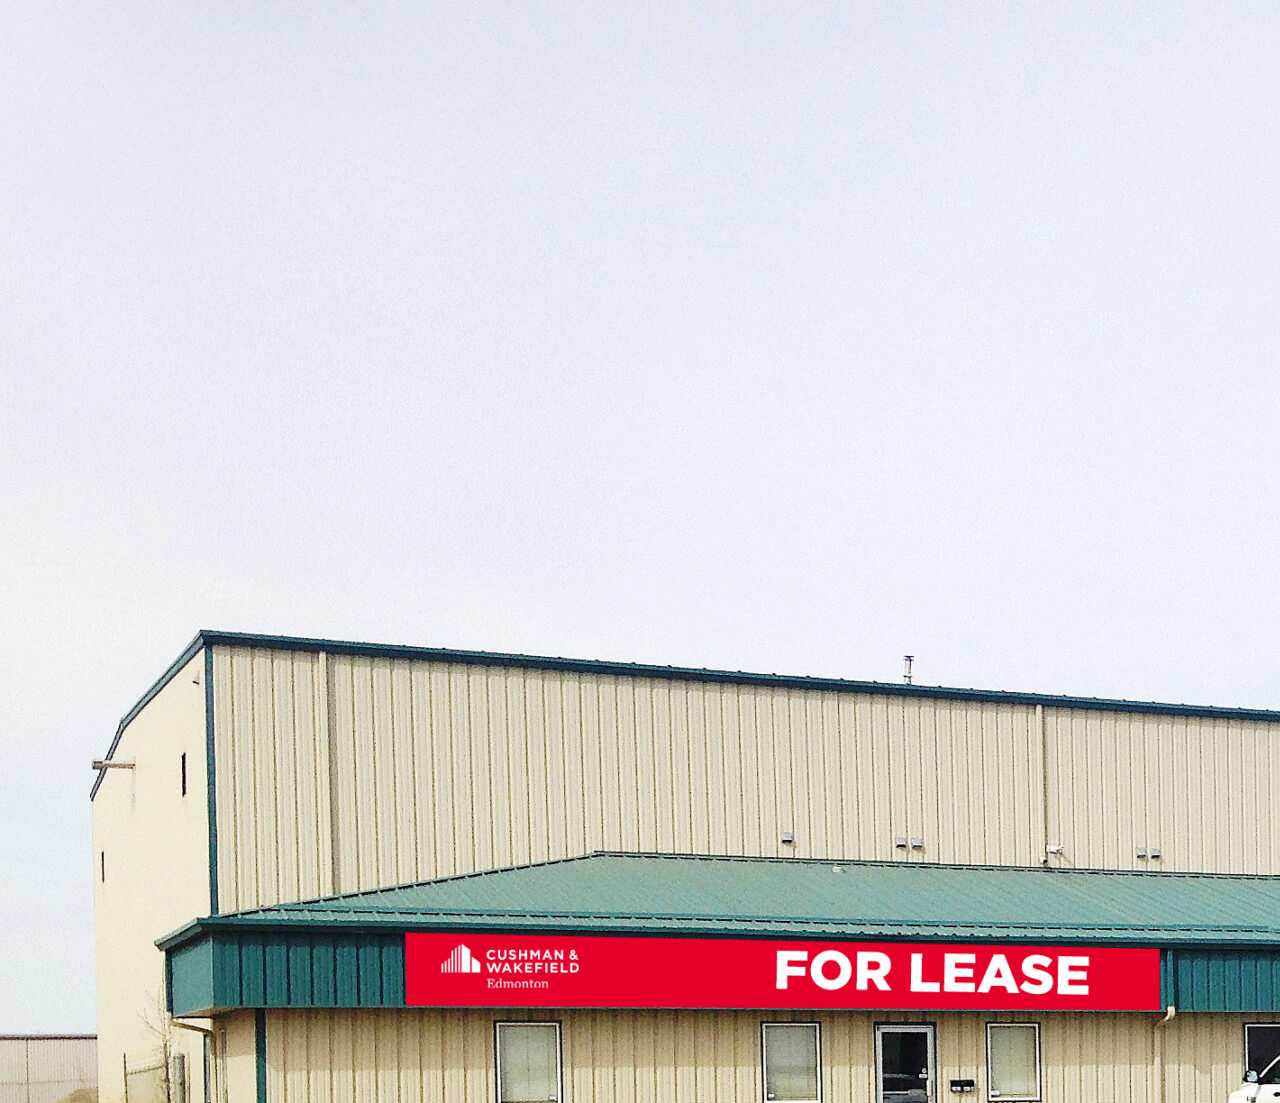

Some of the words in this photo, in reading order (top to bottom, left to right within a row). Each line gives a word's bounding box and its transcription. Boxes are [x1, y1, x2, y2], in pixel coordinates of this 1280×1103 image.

[486, 949, 564, 960] CUSHMAN
[569, 949, 579, 960] &
[486, 962, 580, 973] WAKEFIELD
[775, 950, 892, 991] FOR
[910, 953, 1089, 995] LEASE
[486, 978, 549, 989] Edmonton
